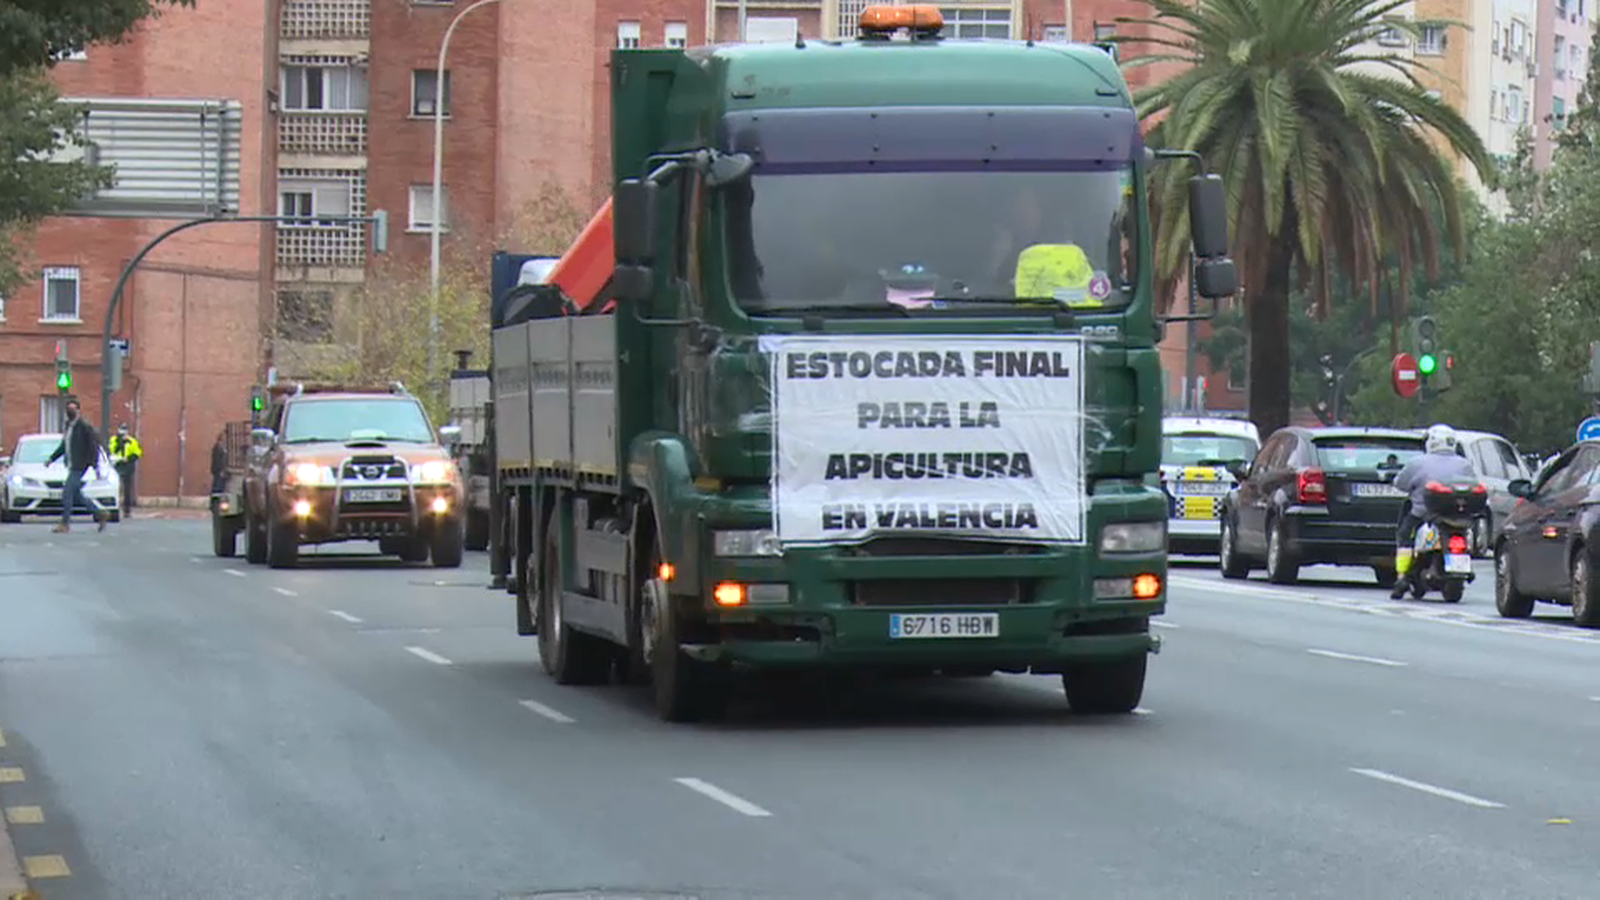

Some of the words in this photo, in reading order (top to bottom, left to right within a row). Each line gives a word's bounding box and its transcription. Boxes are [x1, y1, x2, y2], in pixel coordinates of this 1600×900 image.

[787, 351, 966, 379] ESTOCADA
[974, 350, 1070, 378] FINAL
[857, 401, 951, 429] PARA
[959, 401, 1001, 428] LA
[825, 452, 1034, 480] APICULTURA
[822, 503, 867, 530] EN
[874, 502, 1038, 529] VALENCIA
[903, 616, 951, 635] 6716
[957, 616, 993, 635] HBW
